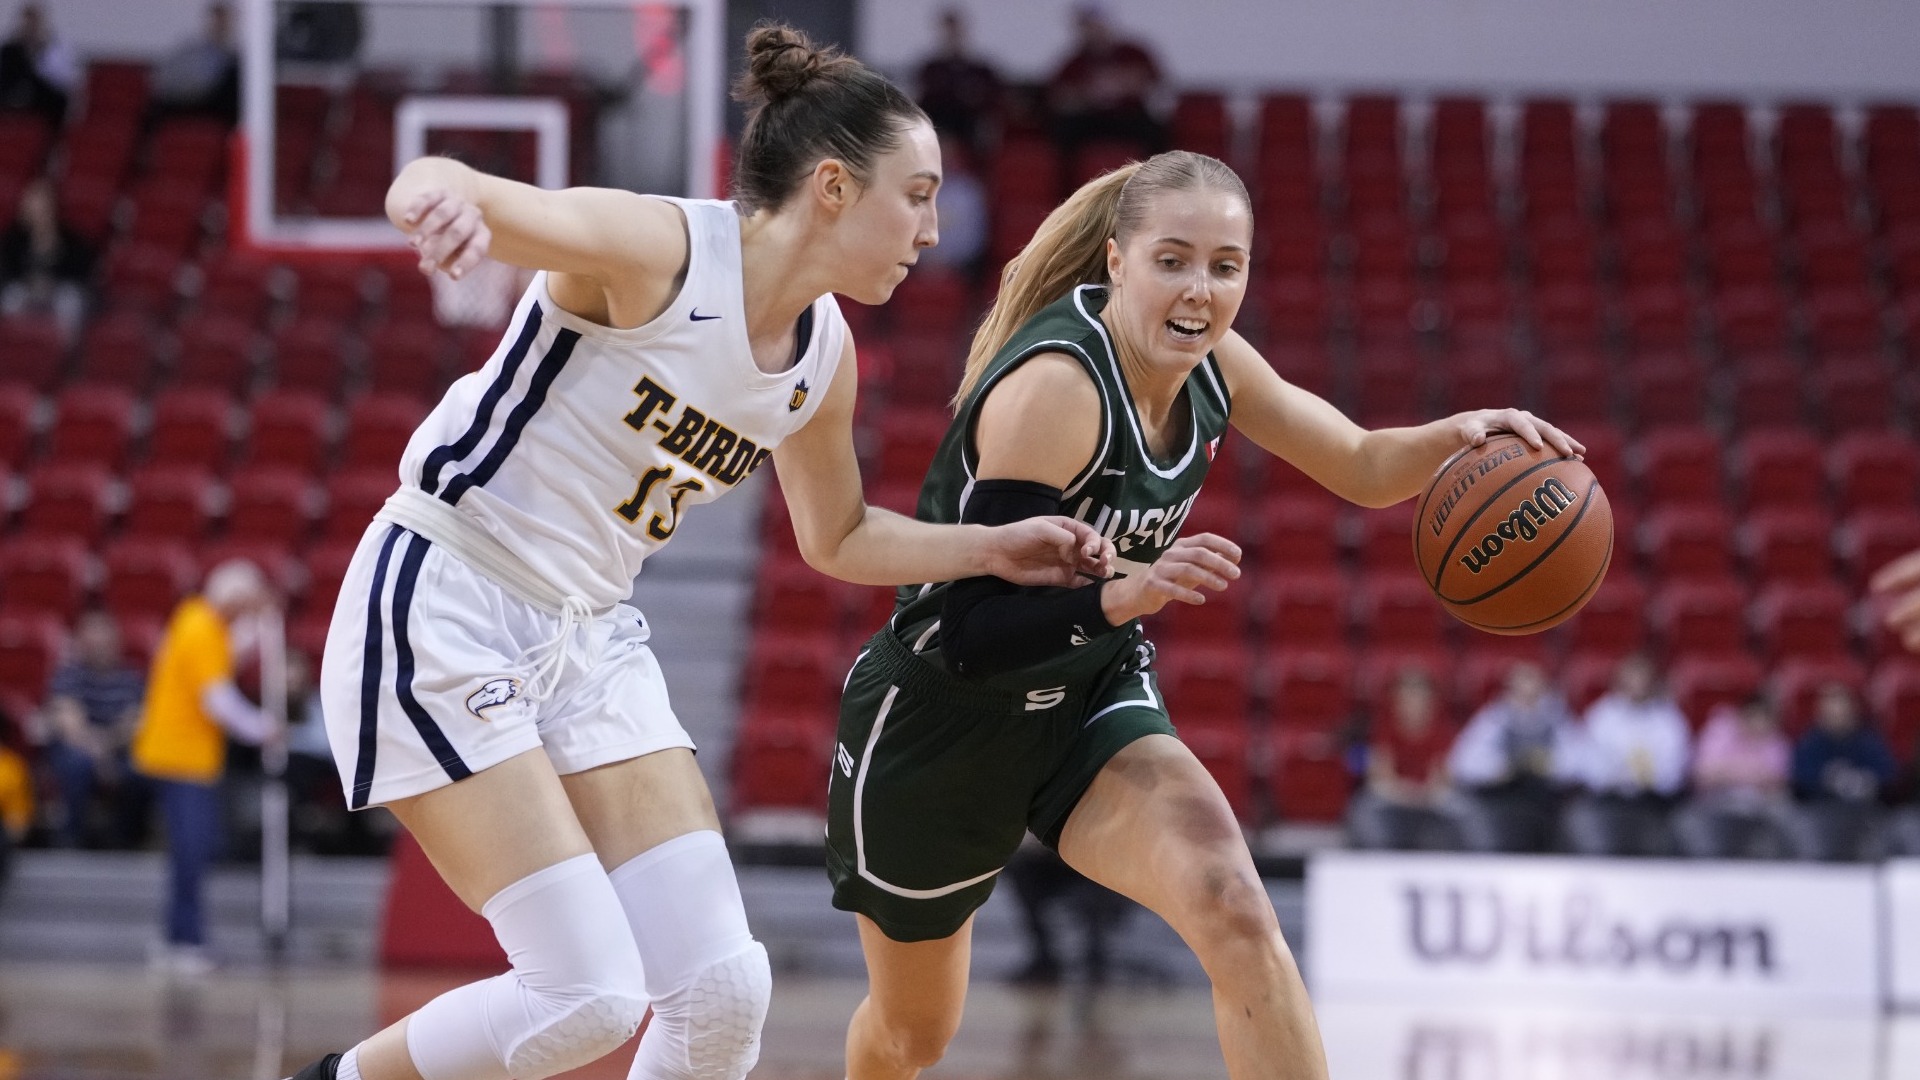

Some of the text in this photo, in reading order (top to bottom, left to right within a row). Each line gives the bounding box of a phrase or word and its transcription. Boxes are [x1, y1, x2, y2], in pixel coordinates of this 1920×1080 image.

[1429, 445, 1524, 537] EVOLUTION
[1459, 477, 1578, 574] Wilson
[1402, 881, 1778, 975] Wilson
